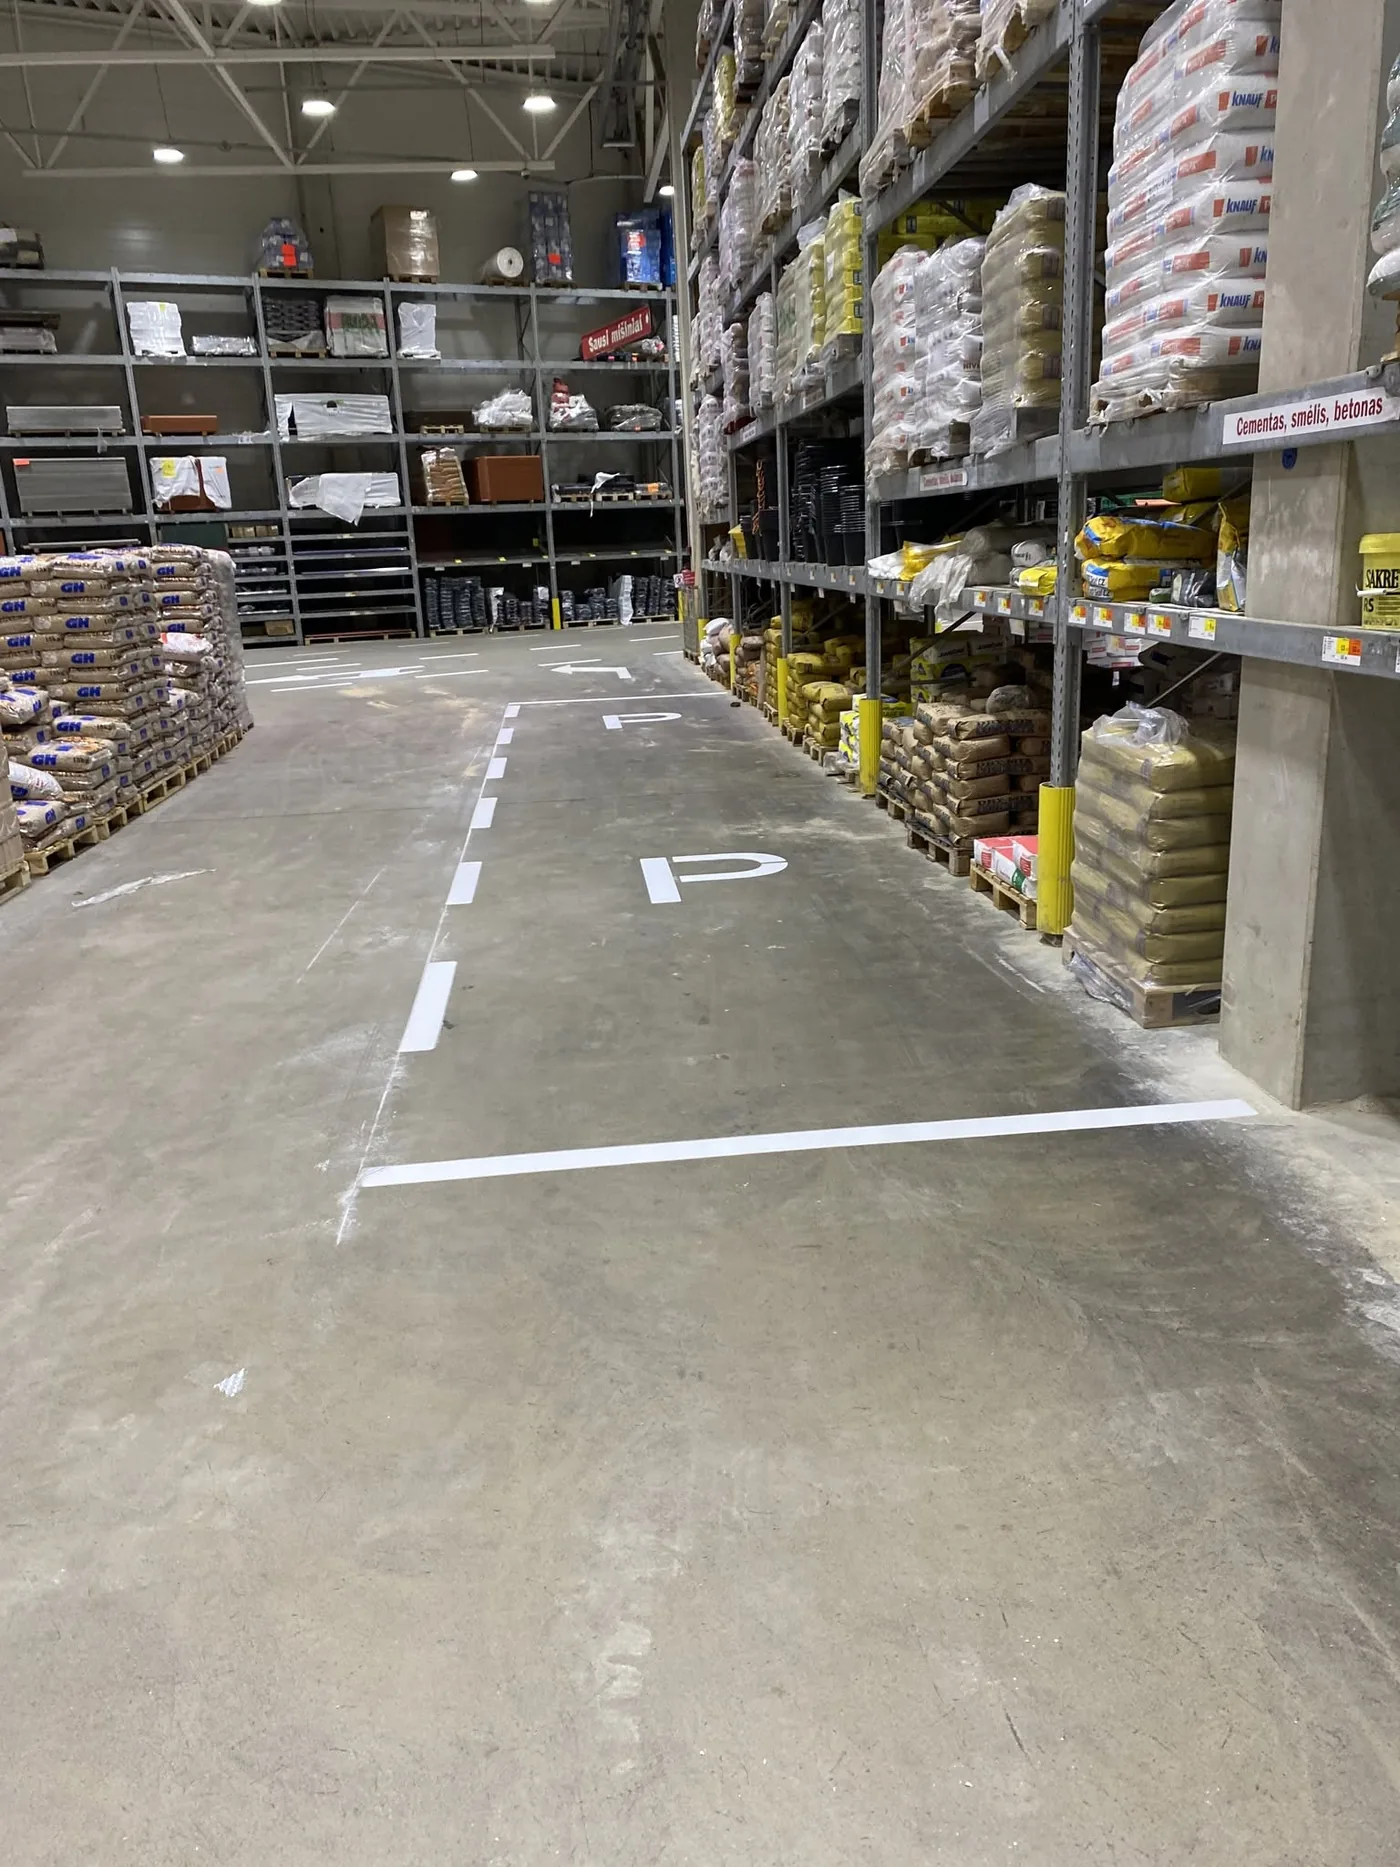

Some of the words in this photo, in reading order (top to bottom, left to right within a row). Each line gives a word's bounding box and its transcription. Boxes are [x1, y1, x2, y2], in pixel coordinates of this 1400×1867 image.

[1231, 90, 1263, 109] KNAUF
[1226, 198, 1258, 215] KNAUF
[1219, 292, 1251, 308] KNAUF
[588, 329, 609, 352] Sausi
[1236, 413, 1288, 436] Cementas,
[1291, 403, 1330, 428] smėlis,
[1333, 397, 1383, 421] betonas
[1366, 568, 1400, 589] SAKRE
[602, 712, 682, 730] P
[640, 852, 789, 905] P
